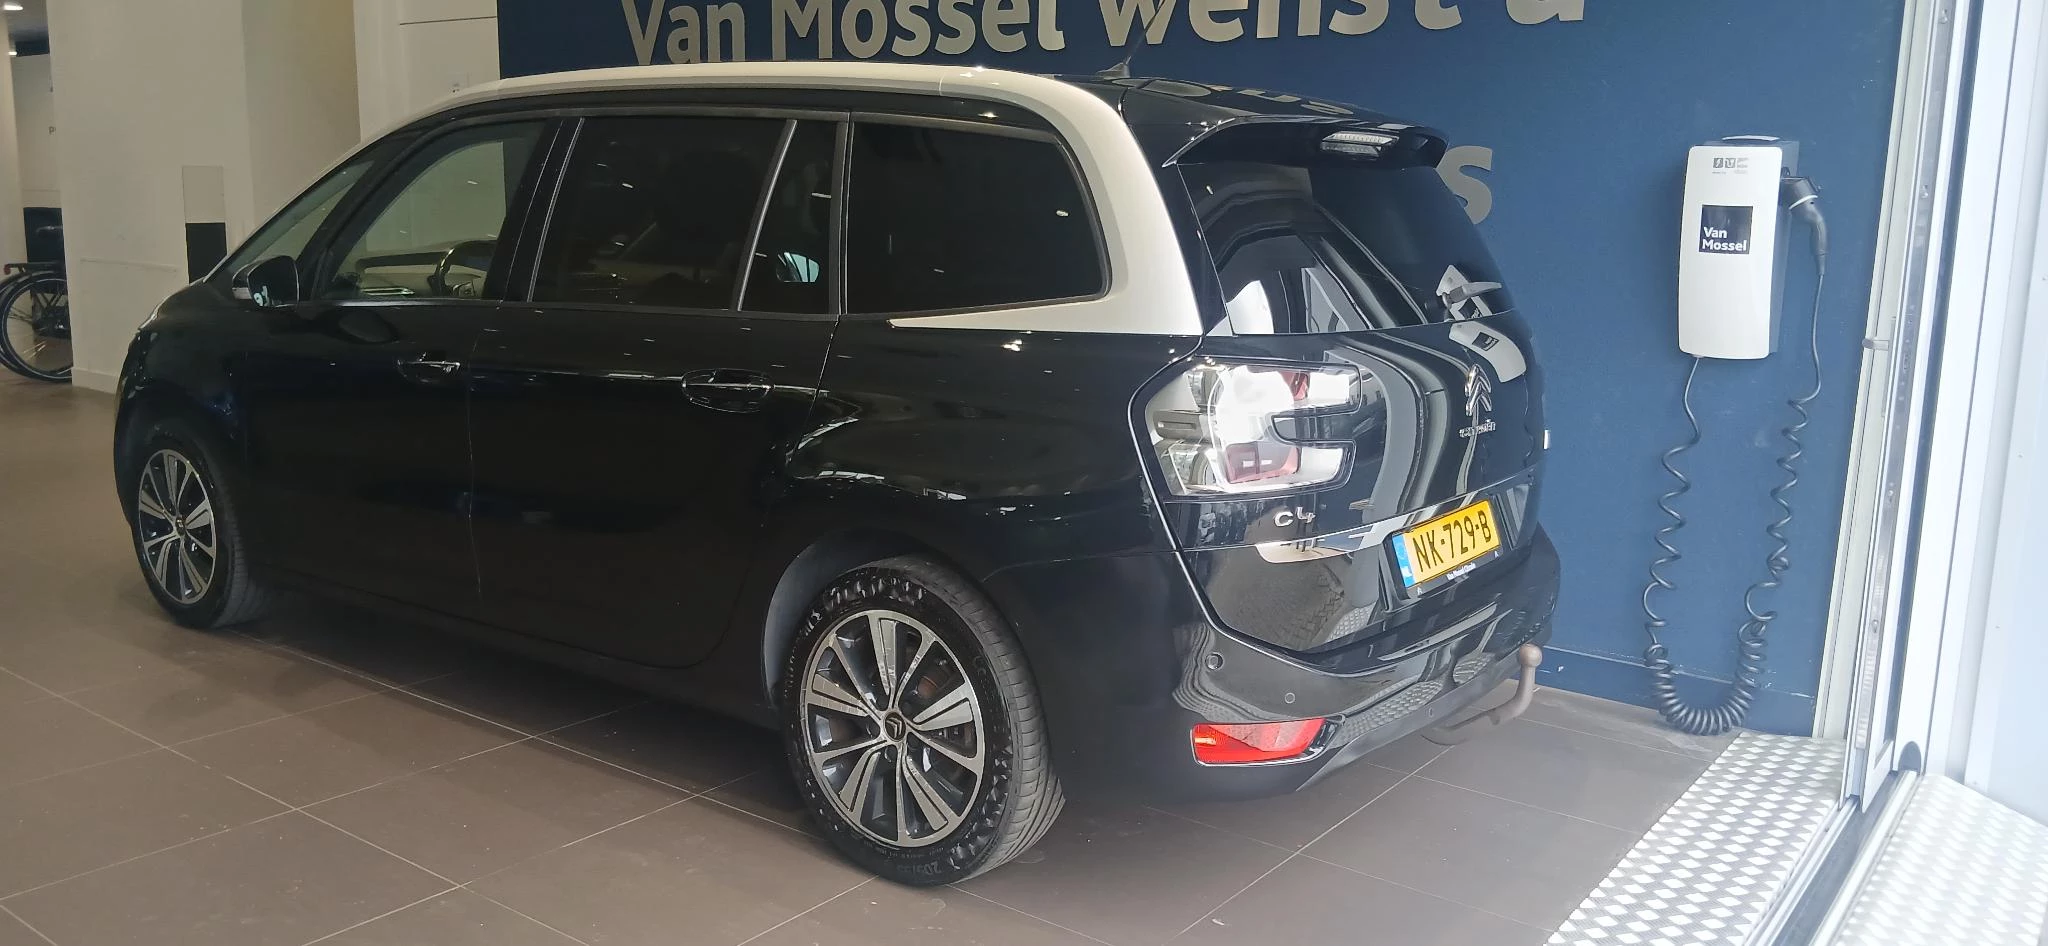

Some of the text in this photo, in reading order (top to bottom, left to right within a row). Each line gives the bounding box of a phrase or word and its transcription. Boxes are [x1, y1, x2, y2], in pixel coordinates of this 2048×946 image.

[622, 0, 746, 66] Van
[771, 0, 1066, 61] Mossel
[1703, 226, 1728, 239] Van
[1701, 238, 1748, 252] Mossel
[1274, 506, 1316, 527] C4
[1412, 509, 1492, 573] NK-729-B
